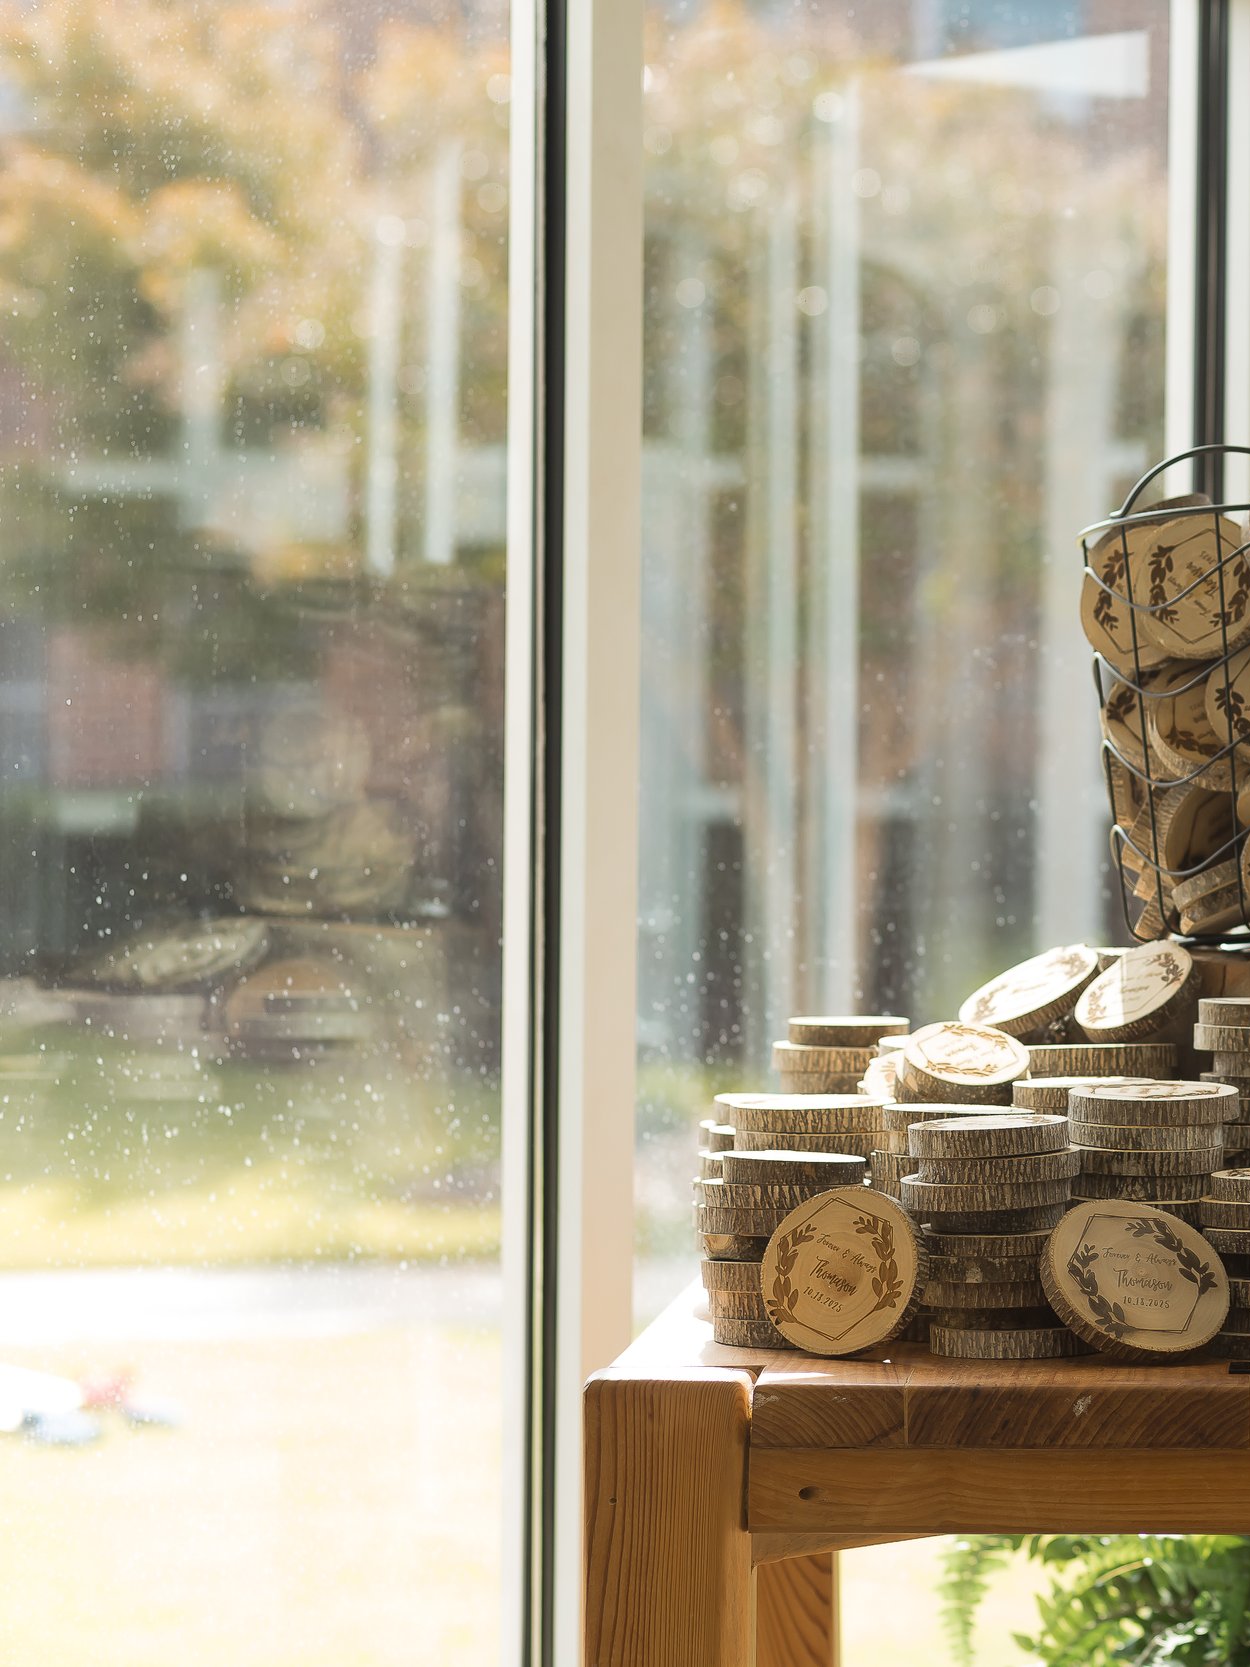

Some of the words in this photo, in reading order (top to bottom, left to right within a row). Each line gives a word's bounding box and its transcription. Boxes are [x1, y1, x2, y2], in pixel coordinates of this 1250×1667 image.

[1186, 562, 1219, 599] Thoason
[817, 1233, 840, 1252] Forever
[842, 1248, 850, 1259] &
[850, 1253, 877, 1273] Always
[1102, 1247, 1130, 1259] Forever
[1135, 1252, 1142, 1263] &
[1146, 1252, 1177, 1266] Always
[810, 1256, 857, 1296] Thomason
[1113, 1267, 1173, 1292] Thomason
[803, 1286, 842, 1313] 10.18.2025
[1123, 1295, 1170, 1309] 10.18.2025
